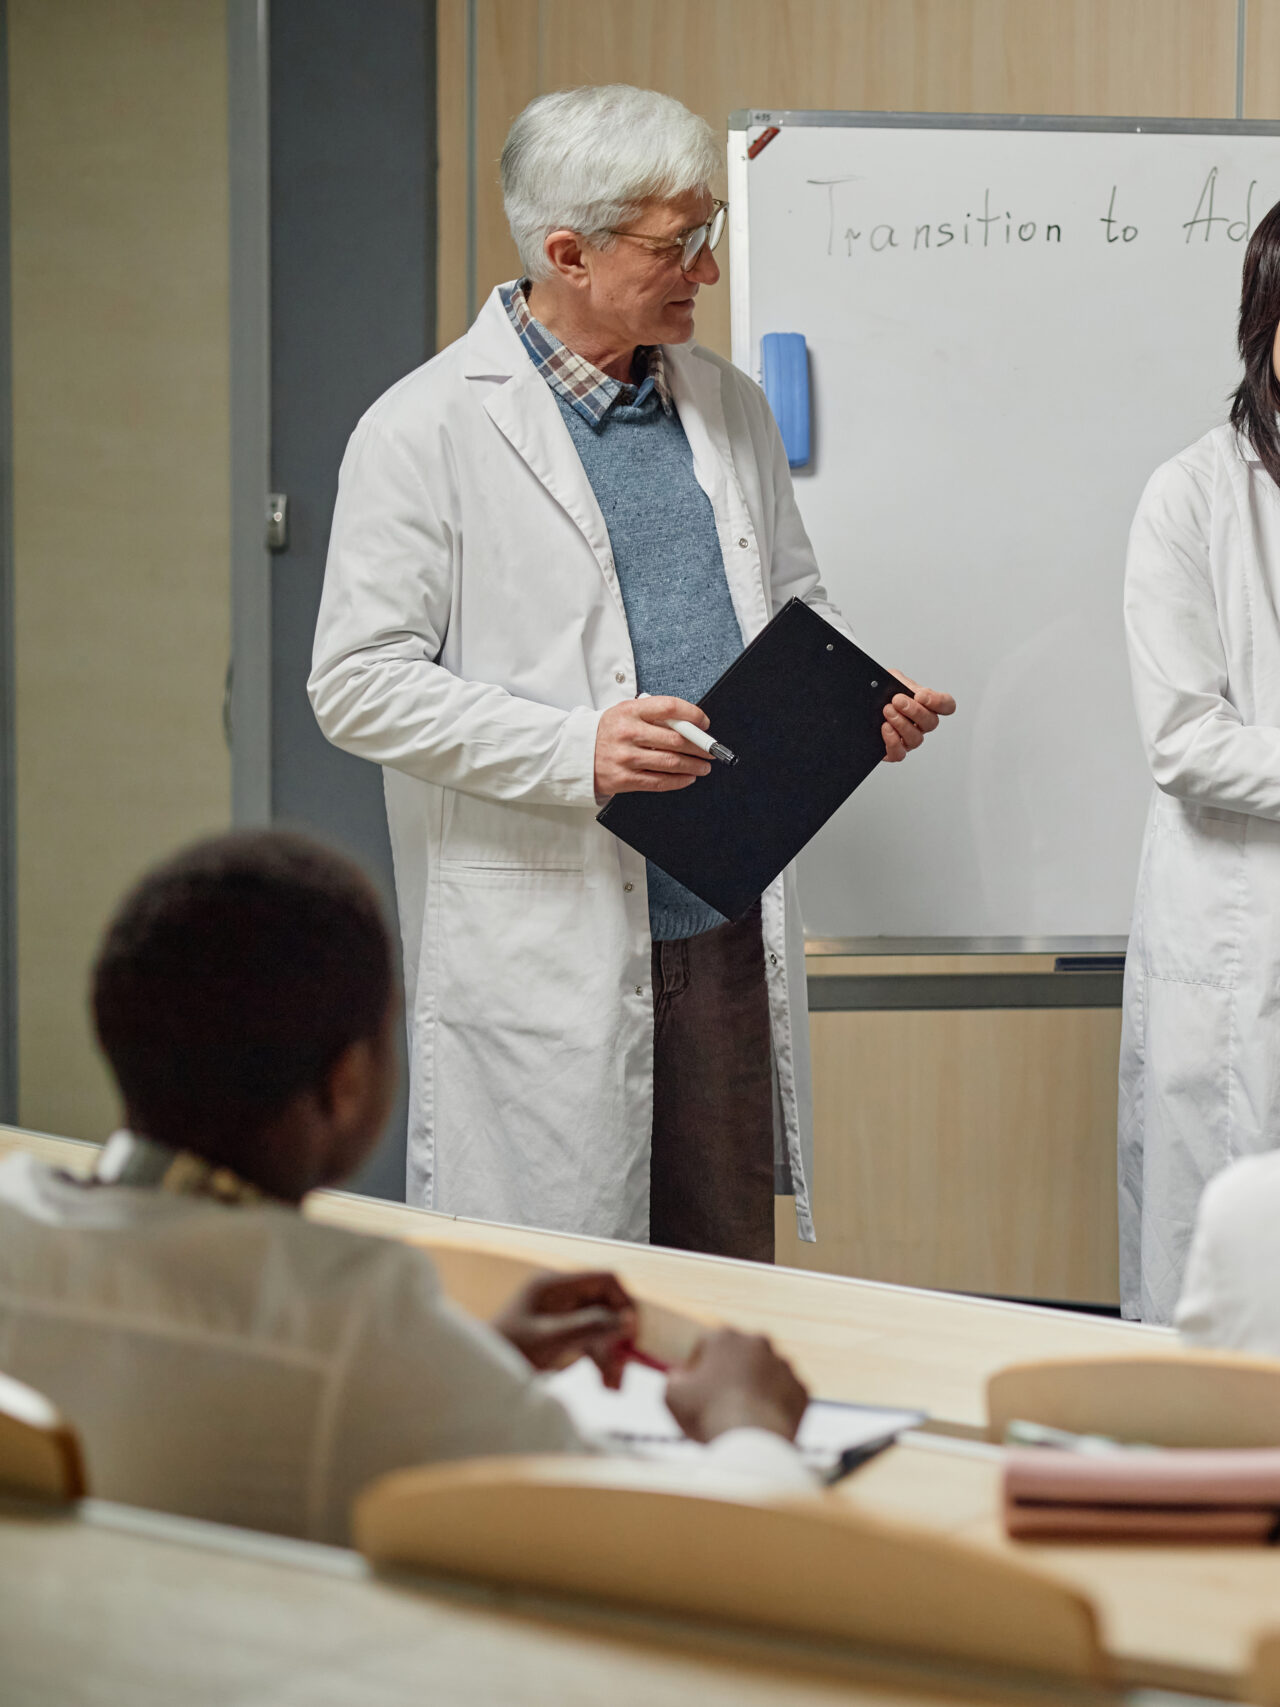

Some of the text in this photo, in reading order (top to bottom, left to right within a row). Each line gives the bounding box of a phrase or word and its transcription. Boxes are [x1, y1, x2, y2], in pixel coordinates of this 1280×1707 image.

[806, 165, 1257, 257] Transition to Ad
